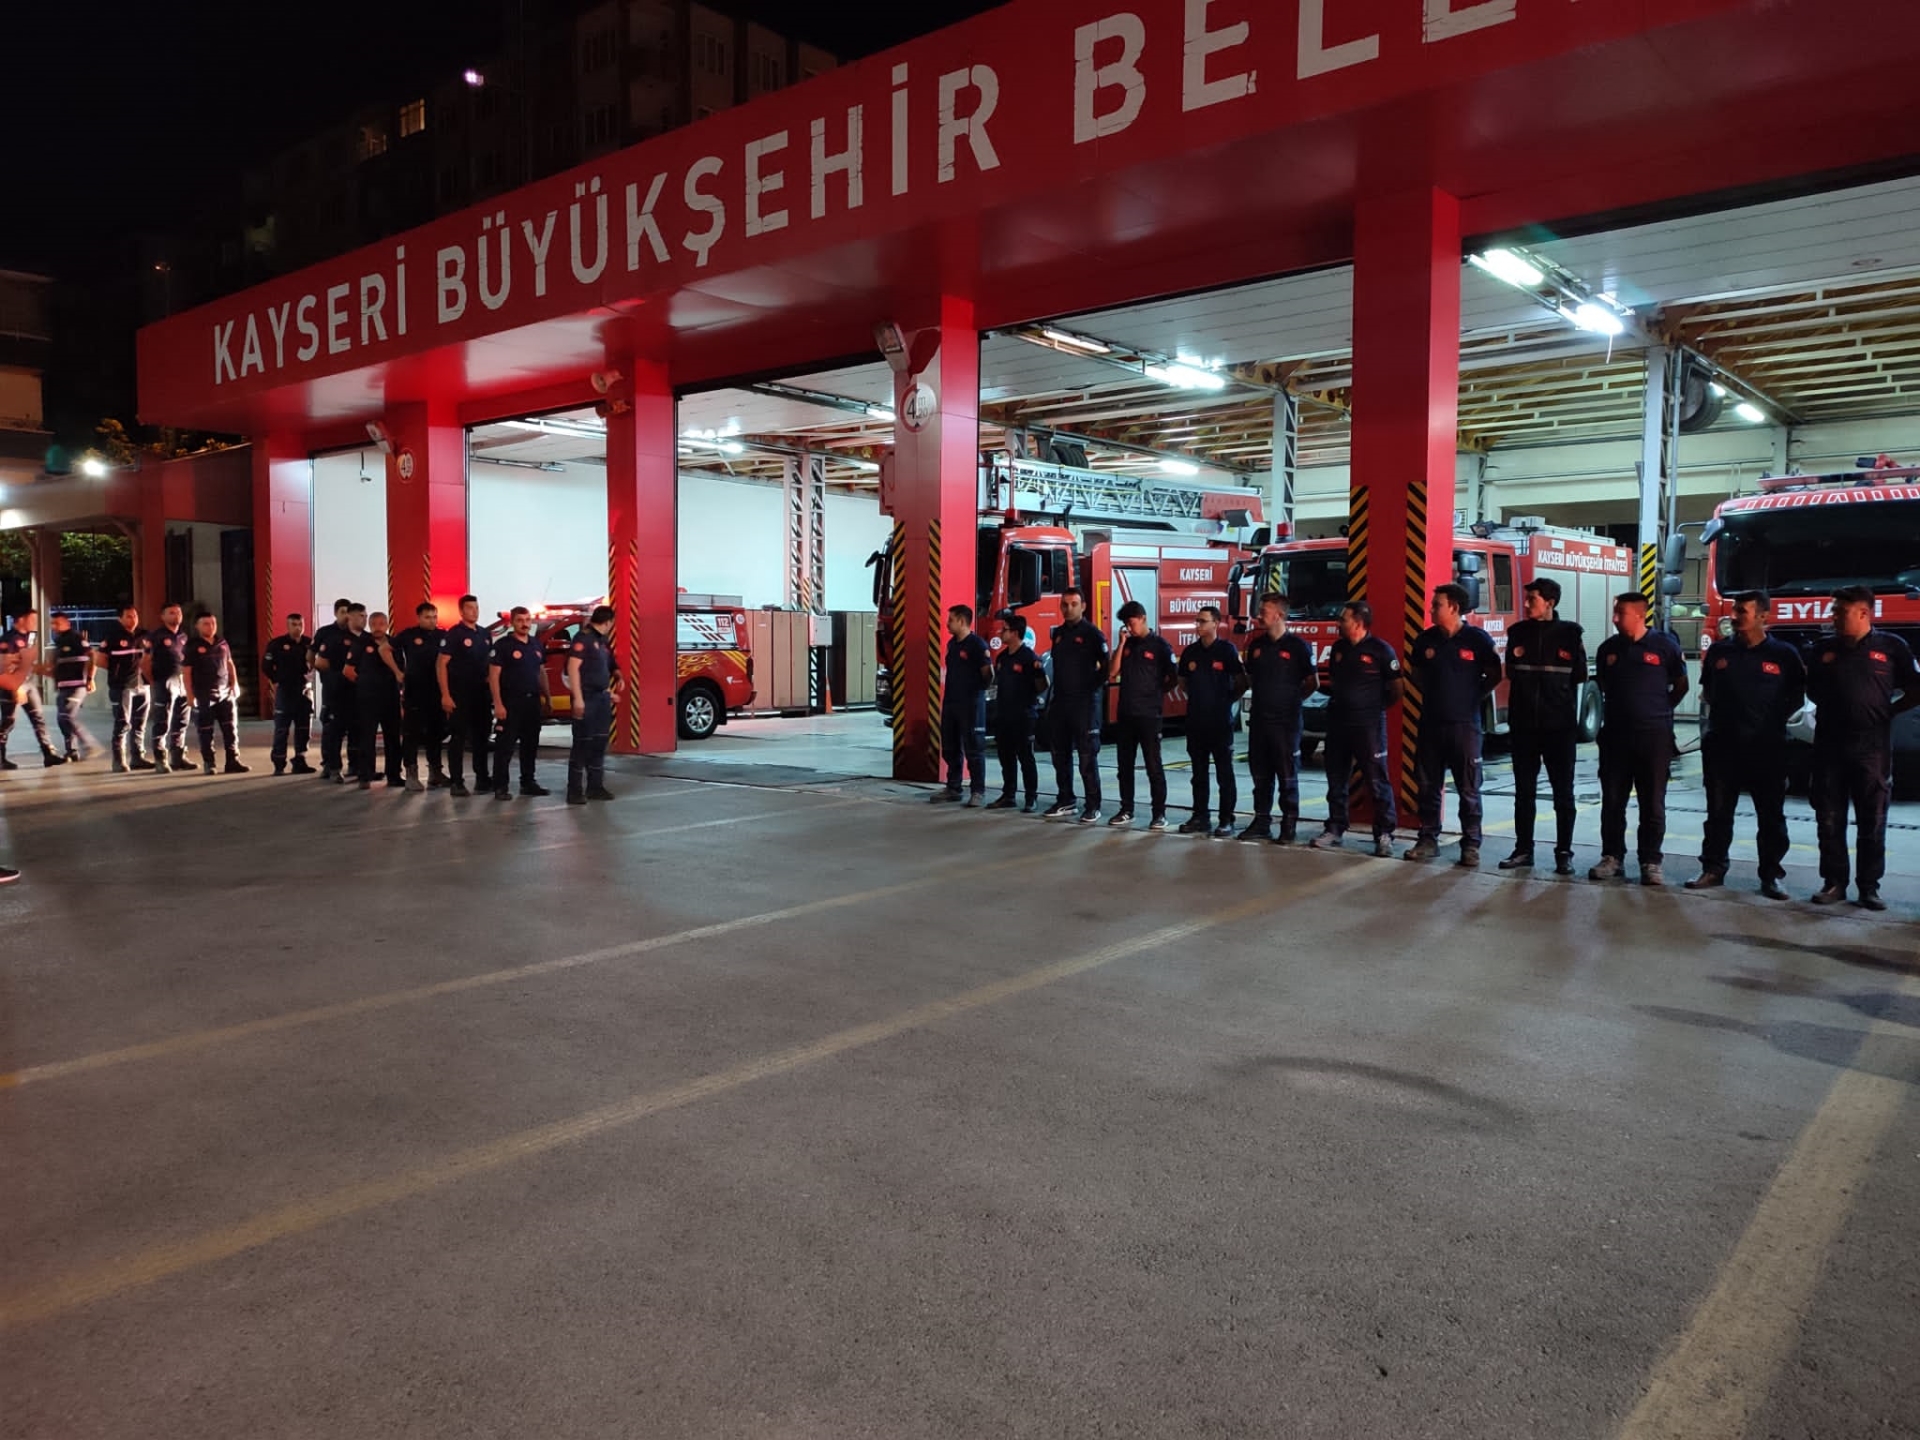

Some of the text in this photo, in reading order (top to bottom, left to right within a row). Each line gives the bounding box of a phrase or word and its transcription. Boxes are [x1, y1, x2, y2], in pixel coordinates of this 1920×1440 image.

[214, 0, 1517, 384] KAYSERİ BÜYÜKŞEHİR BEL
[1538, 549, 1564, 566] KAYSERİ
[1179, 565, 1213, 581] KAYSERİ
[717, 617, 729, 626] 112
